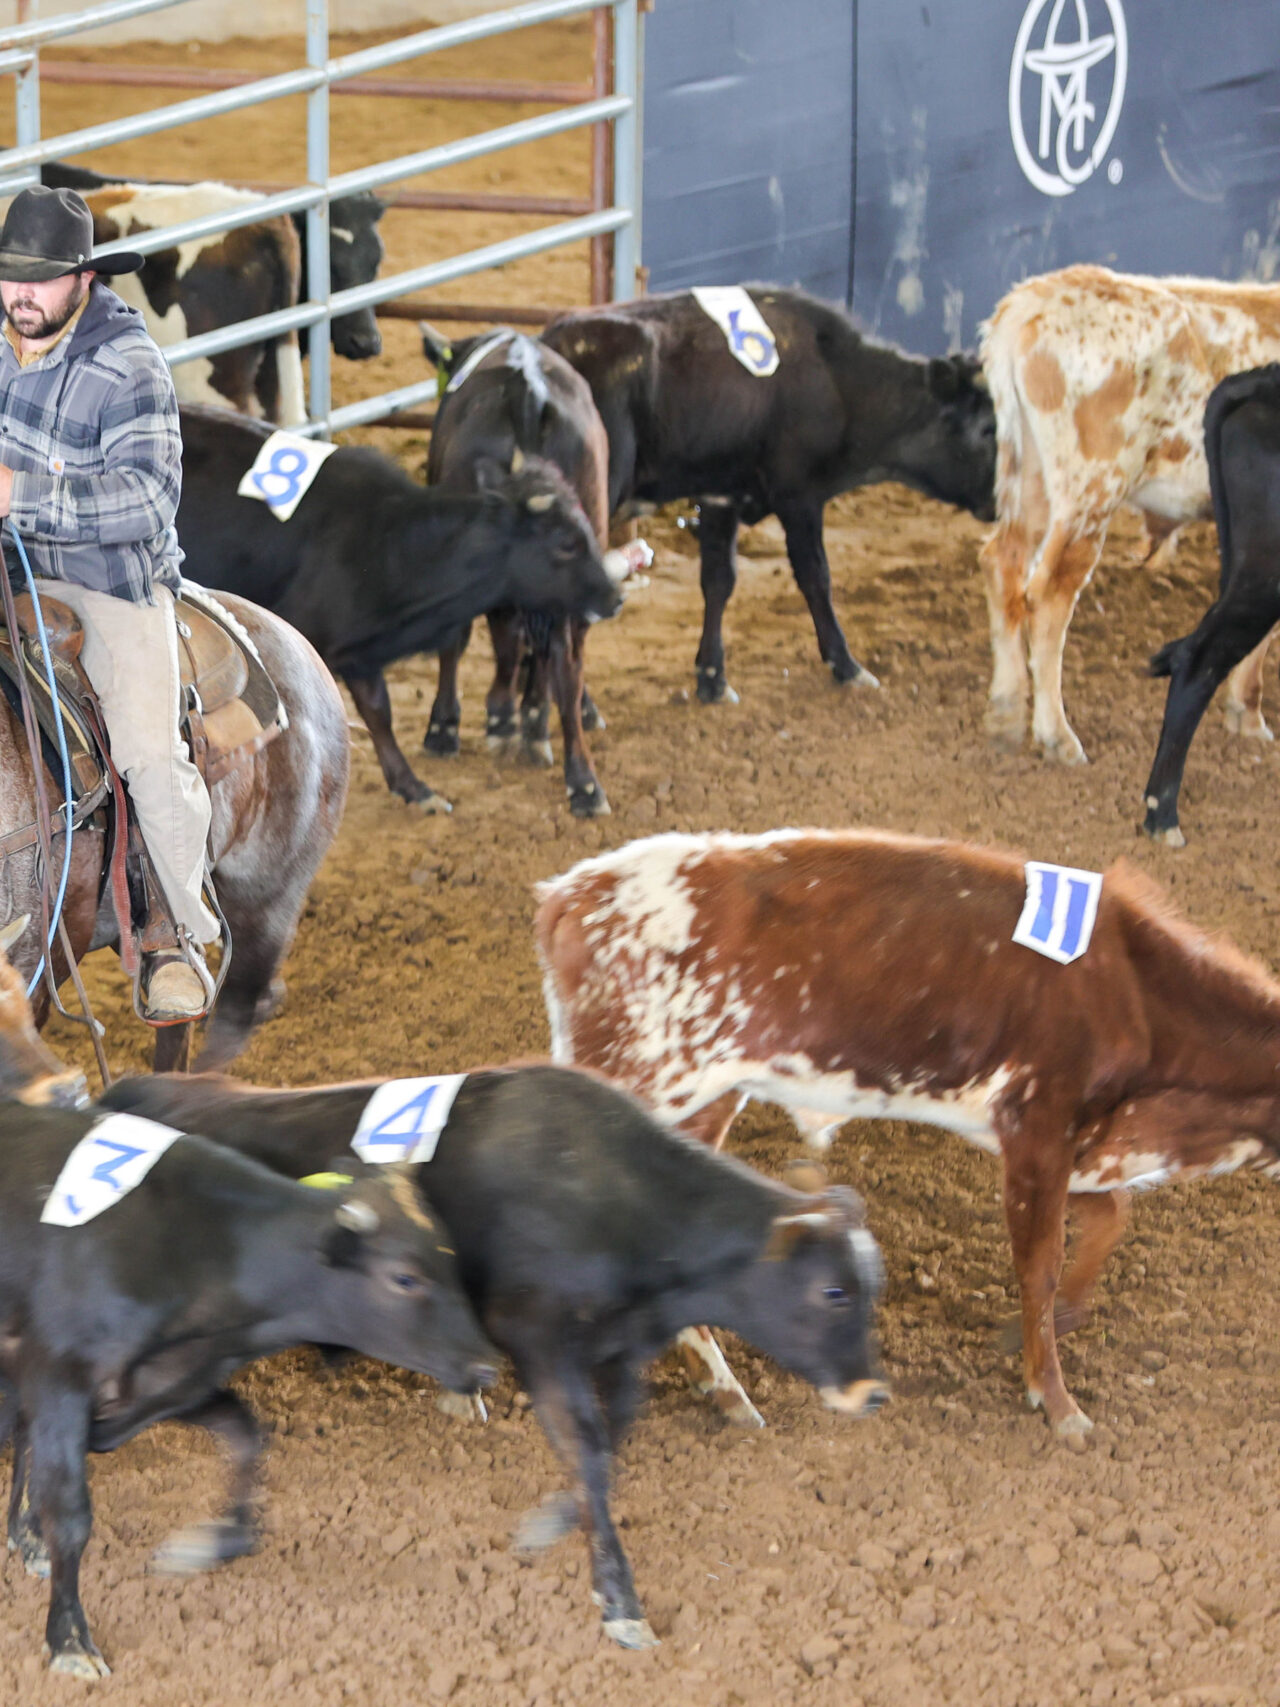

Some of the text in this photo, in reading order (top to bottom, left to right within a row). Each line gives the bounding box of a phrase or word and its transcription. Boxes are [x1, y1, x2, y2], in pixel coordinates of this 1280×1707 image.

[252, 447, 308, 507] 8
[1028, 870, 1090, 956] 11
[366, 1084, 440, 1157] 4
